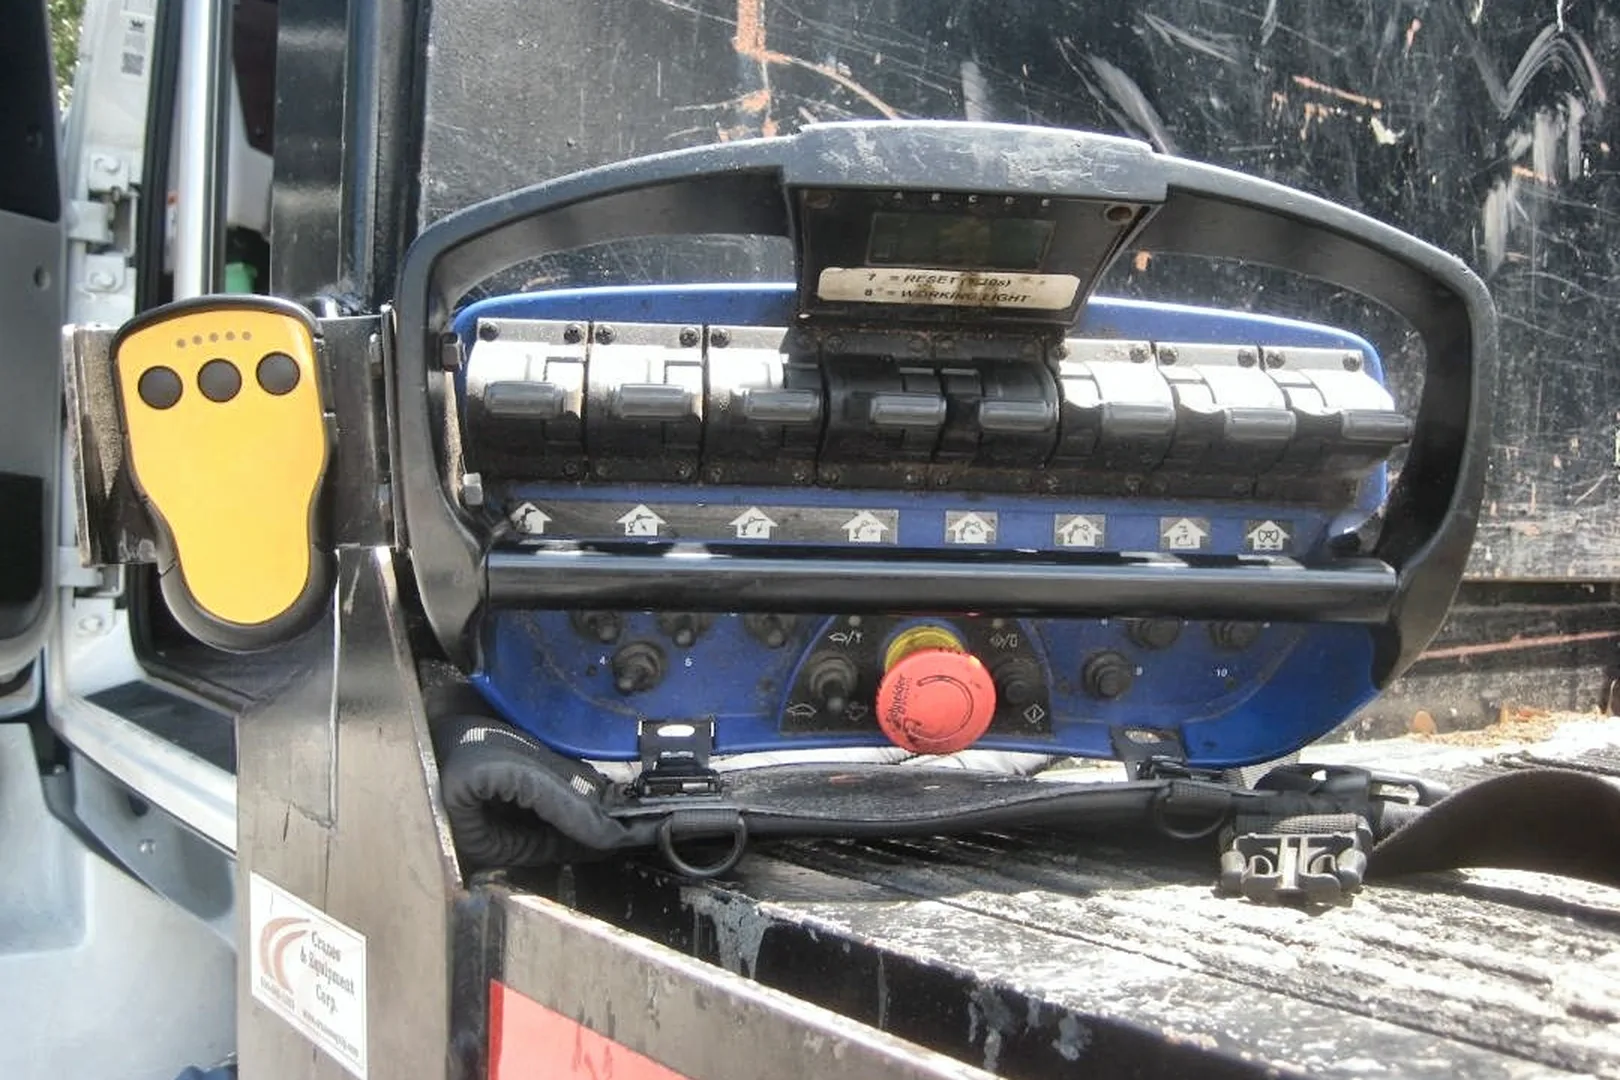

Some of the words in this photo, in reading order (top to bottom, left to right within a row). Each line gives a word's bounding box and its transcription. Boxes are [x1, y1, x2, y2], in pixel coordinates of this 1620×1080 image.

[903, 275, 957, 285] RESET
[901, 290, 977, 301] WORKING
[981, 293, 1031, 302] LIGHT
[308, 952, 355, 996] Equipment
